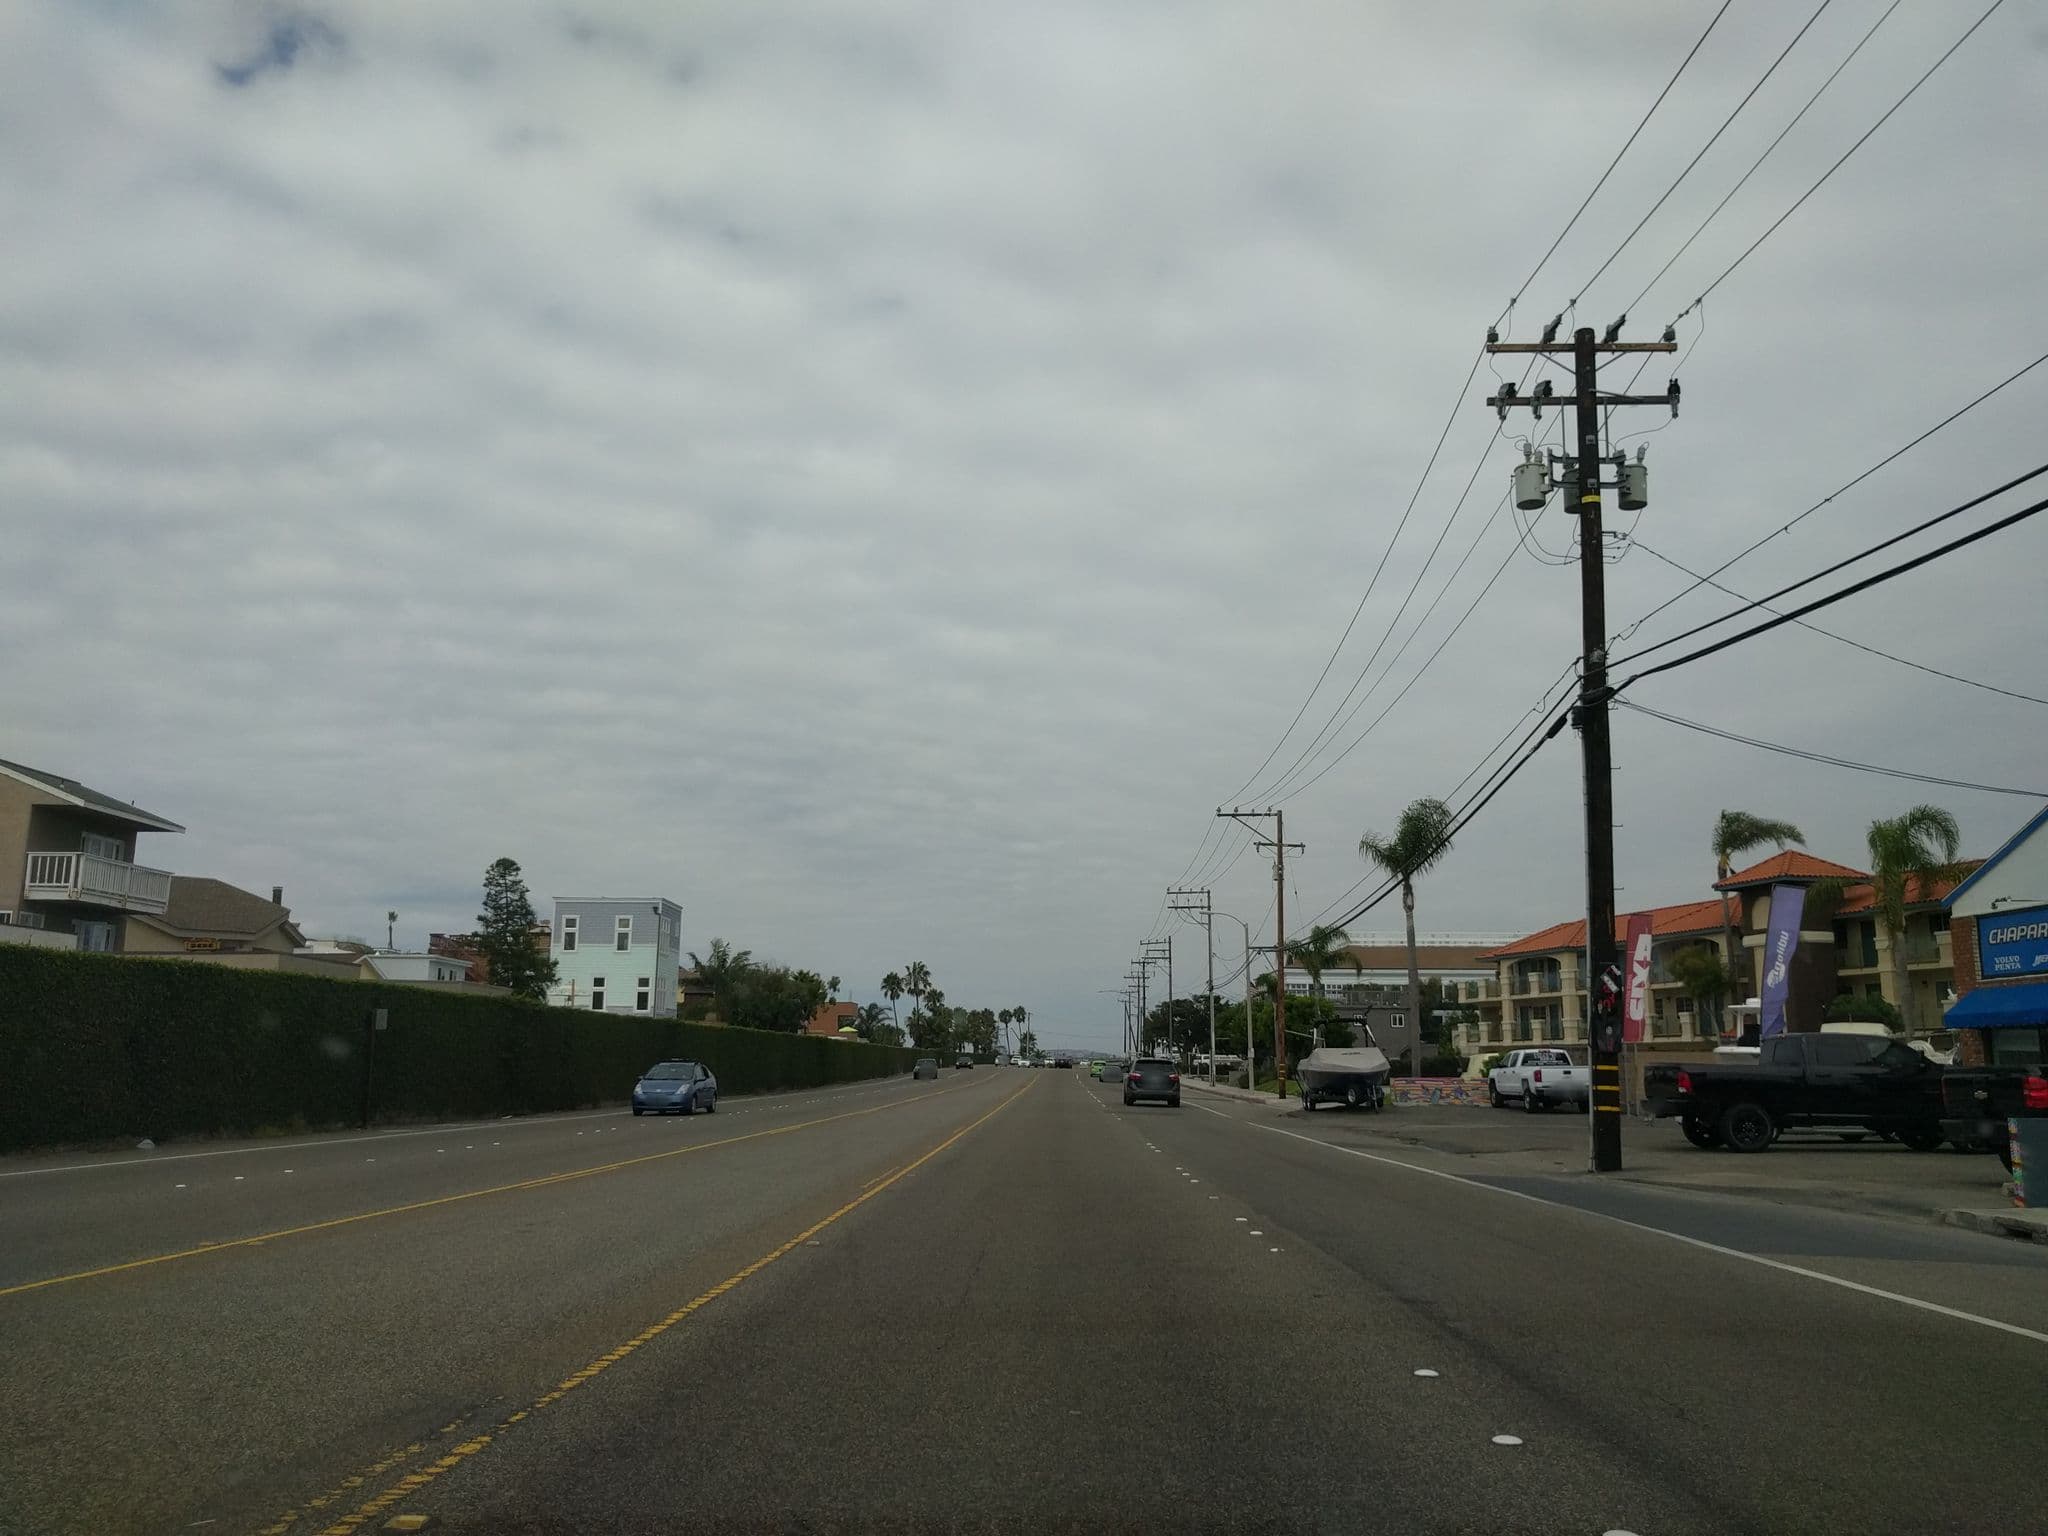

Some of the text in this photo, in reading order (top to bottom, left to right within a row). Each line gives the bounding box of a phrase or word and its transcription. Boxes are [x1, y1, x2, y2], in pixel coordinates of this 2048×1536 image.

[1989, 923, 2048, 944] CHAPAR
[1994, 955, 2020, 964] VOLVO
[1994, 963, 2021, 971] PENTA
